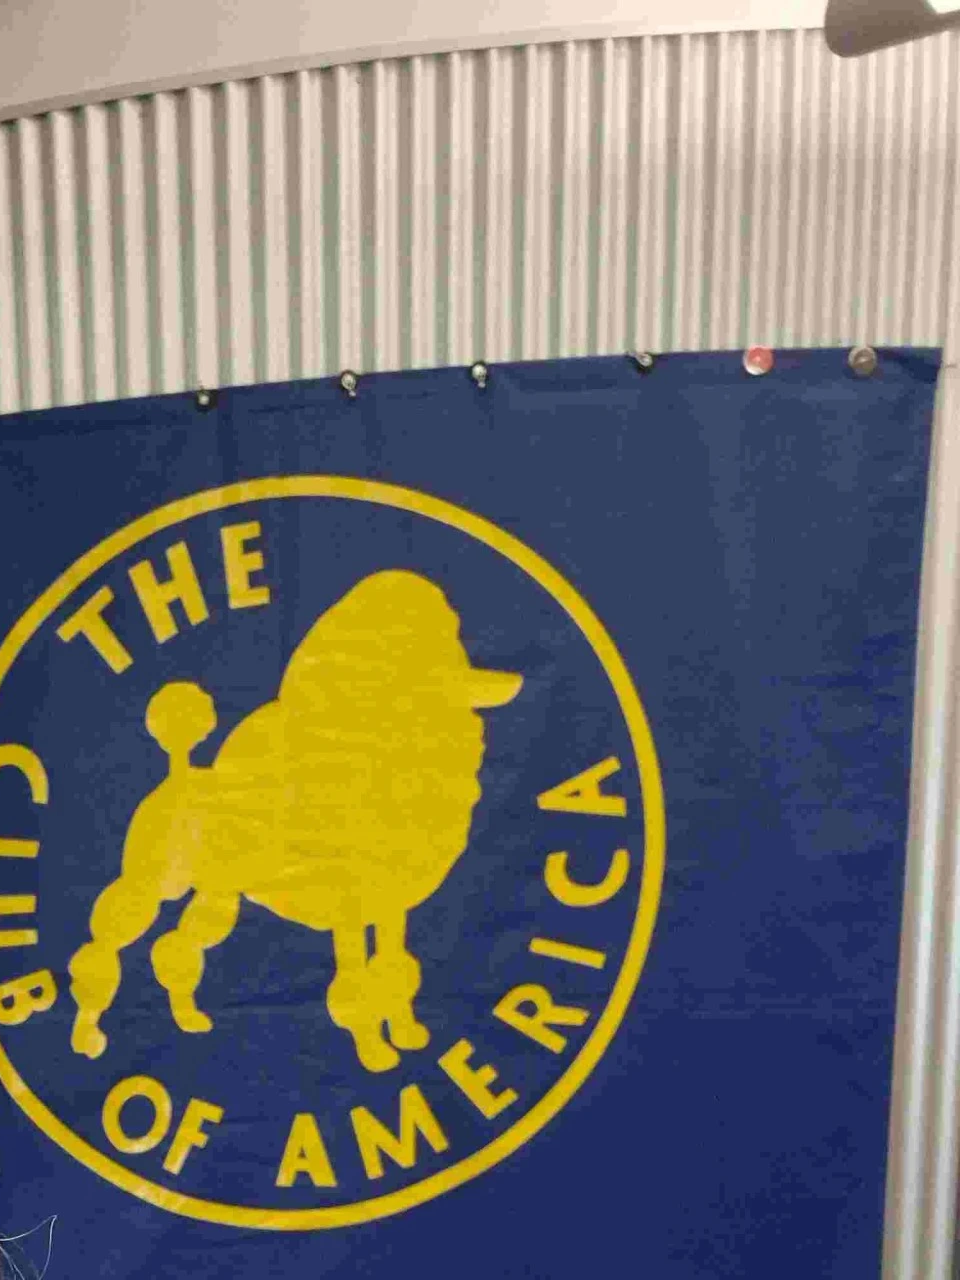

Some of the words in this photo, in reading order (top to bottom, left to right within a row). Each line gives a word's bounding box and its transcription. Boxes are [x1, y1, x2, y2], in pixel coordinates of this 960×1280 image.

[57, 520, 271, 673] THE
[276, 755, 631, 1188] AMERICA
[101, 1074, 225, 1174] OF
